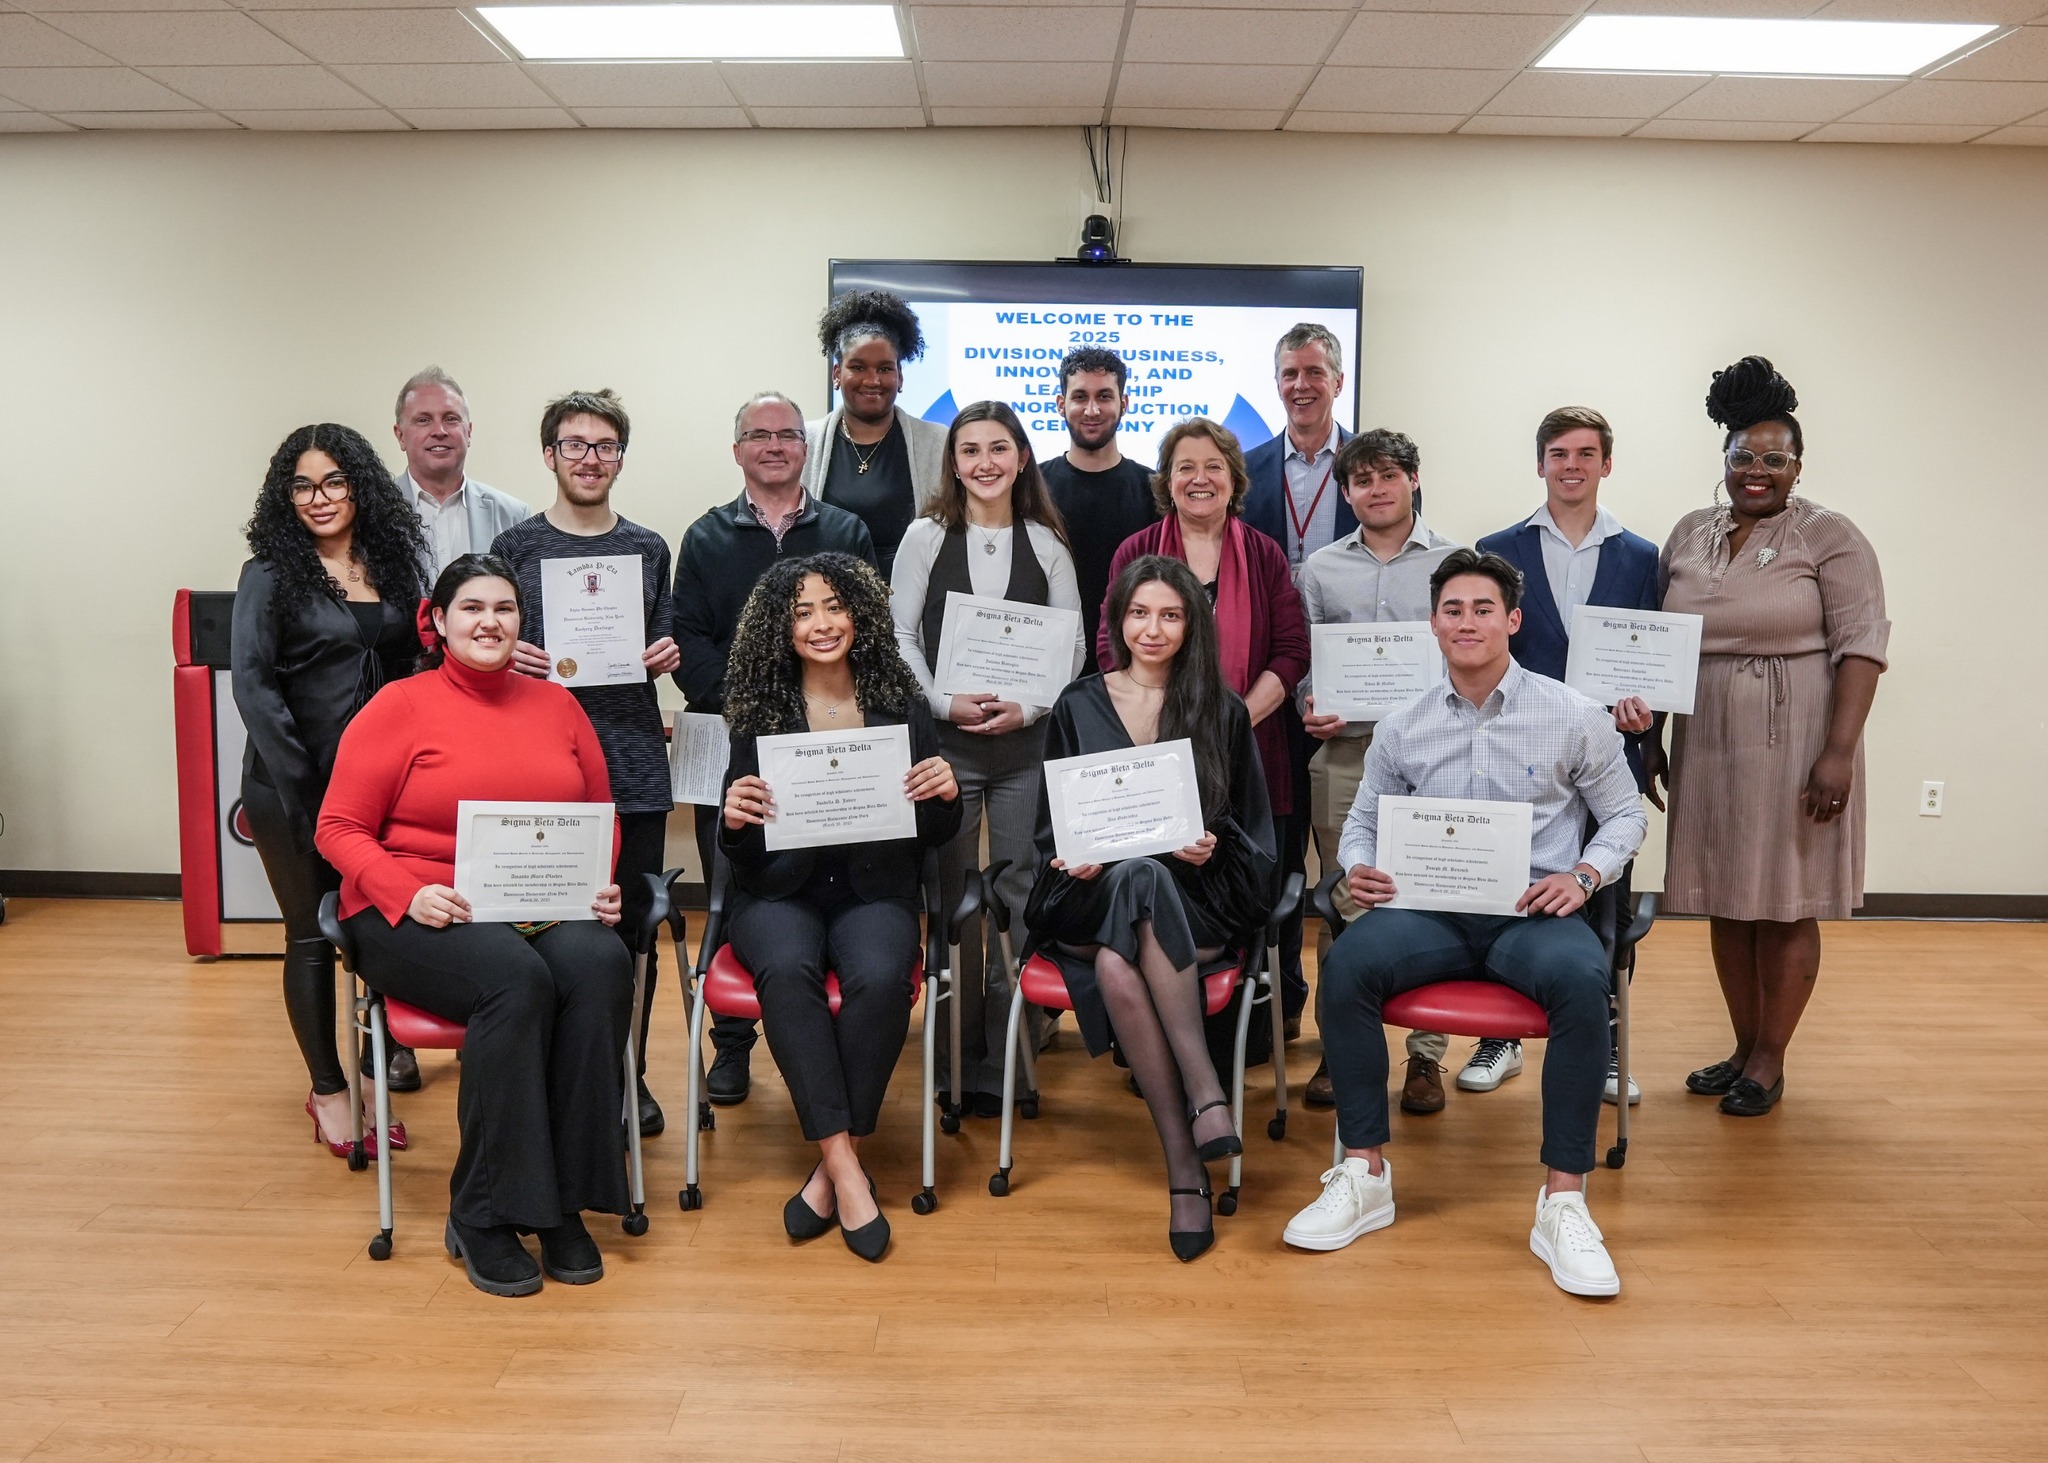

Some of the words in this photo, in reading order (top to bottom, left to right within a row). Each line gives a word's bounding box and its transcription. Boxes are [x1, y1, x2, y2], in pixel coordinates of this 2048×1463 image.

[996, 312, 1106, 325] WELCOME
[1113, 313, 1142, 326] TO
[1150, 314, 1194, 327] THE
[1069, 331, 1120, 343] 2025
[964, 347, 1063, 360] DIVISION
[1146, 368, 1193, 380] AND
[567, 563, 594, 577] Lambda
[596, 561, 605, 570] Pi
[606, 564, 619, 575] Eta
[976, 609, 1001, 620] Sigma
[1003, 614, 1021, 623] Beta
[1023, 617, 1043, 626] Delta
[1603, 620, 1627, 629] Sigma
[1629, 622, 1647, 631] Beta
[1649, 624, 1669, 632] Delta
[1347, 636, 1371, 644] Sigma
[1374, 635, 1391, 643] Beta
[794, 748, 824, 757] Sigma
[826, 746, 846, 755] Beta
[848, 744, 872, 752] Delta
[1079, 768, 1108, 778] Sigma
[1109, 764, 1130, 774] Beta
[1131, 761, 1155, 770] Delta
[501, 817, 531, 827] Sigma
[534, 818, 554, 827] Beta
[557, 818, 580, 826] Delta
[1412, 811, 1441, 822] Sigma
[1444, 813, 1464, 823] Beta
[1467, 815, 1490, 824] Delta
